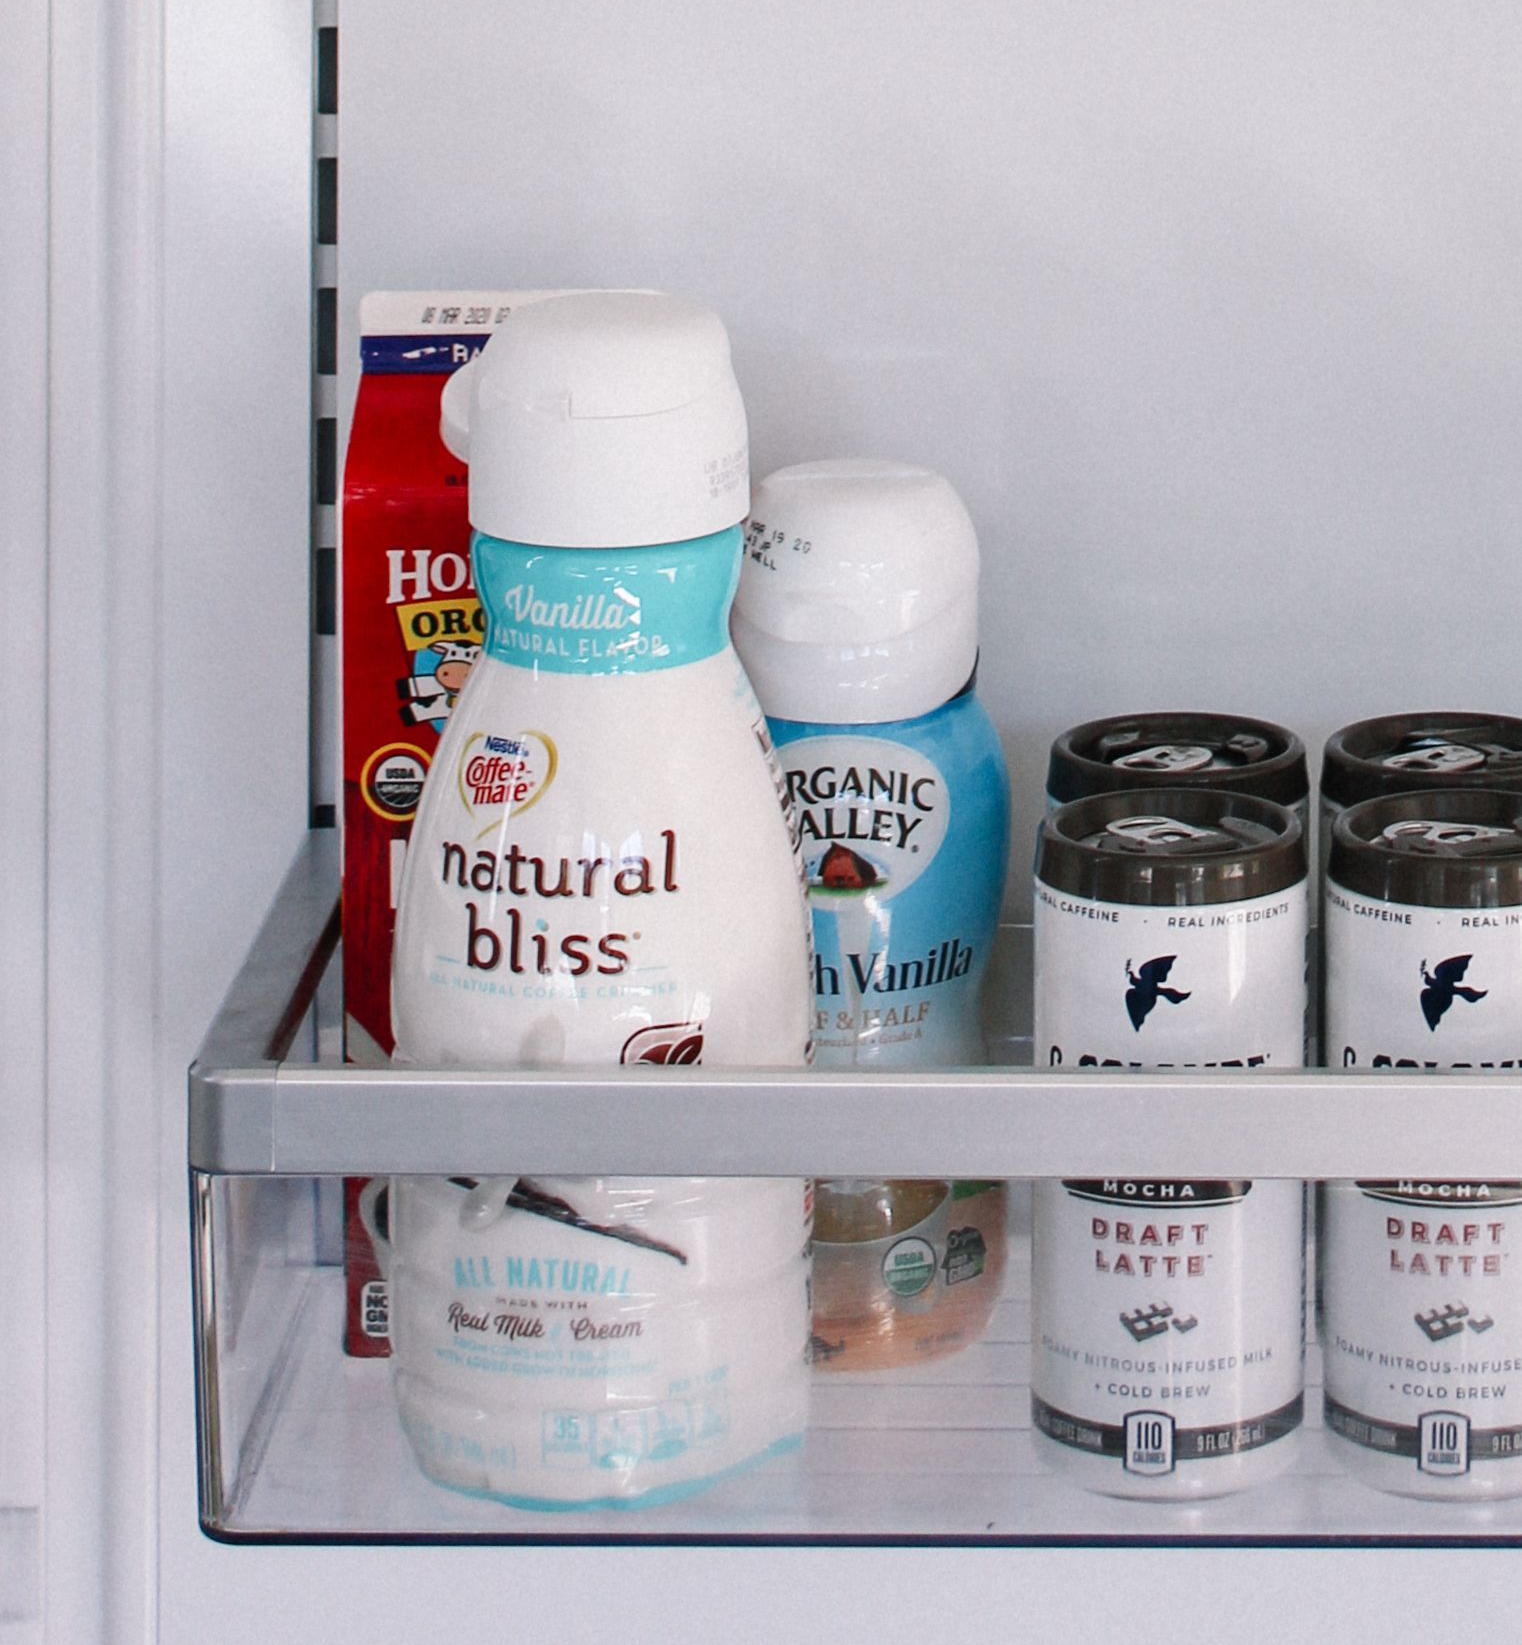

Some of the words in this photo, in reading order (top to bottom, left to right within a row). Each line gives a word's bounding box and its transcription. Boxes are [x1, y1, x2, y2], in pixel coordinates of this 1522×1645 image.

[793, 538, 812, 554] 20
[505, 584, 628, 630] Vanilla
[494, 628, 570, 657] NATURAL
[385, 768, 415, 779] USDA
[473, 780, 528, 804] mate
[788, 768, 935, 814] RGANIC
[799, 810, 922, 850] ALLEY
[442, 830, 677, 897] natural
[1168, 917, 1204, 927] REAL
[1462, 917, 1498, 927] REAL
[465, 903, 630, 976] bliss
[847, 939, 972, 994] Vanilla
[863, 1000, 931, 1027] HALF
[1103, 1180, 1195, 1198] MOCHA
[1398, 1181, 1491, 1198] MOCHA
[1091, 1217, 1209, 1246] DRAFT
[1386, 1217, 1504, 1246] DRAFT
[454, 1256, 494, 1288] ALL
[507, 1256, 630, 1294] NATURAL
[1095, 1250, 1205, 1278] LATTE
[1389, 1249, 1501, 1278] LATTE
[448, 1302, 488, 1332] Real
[495, 1315, 545, 1340] Milk
[570, 1318, 644, 1341] Cream
[1108, 1383, 1151, 1397] COLD
[1161, 1385, 1211, 1397] BREW
[1402, 1383, 1447, 1398] COLD
[1456, 1385, 1507, 1399] BREW
[1137, 1421, 1162, 1450] 110
[1431, 1421, 1457, 1450] 110
